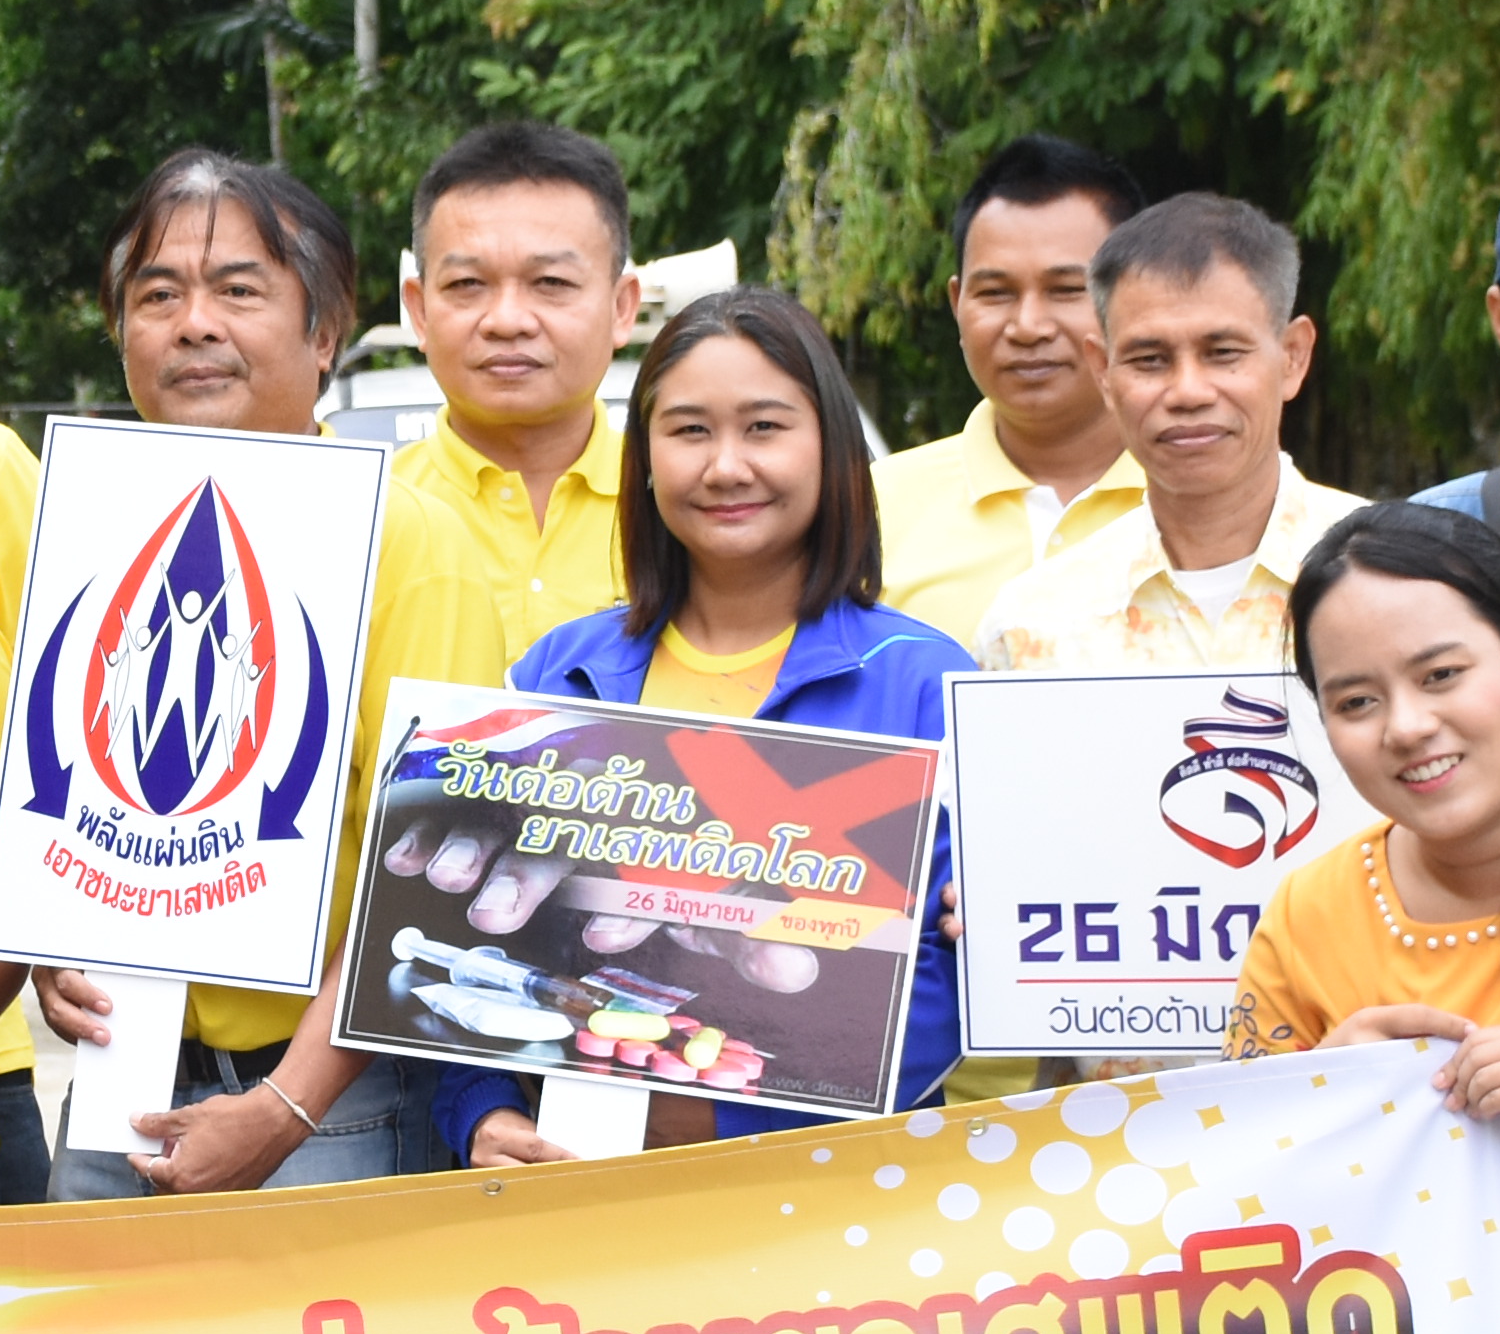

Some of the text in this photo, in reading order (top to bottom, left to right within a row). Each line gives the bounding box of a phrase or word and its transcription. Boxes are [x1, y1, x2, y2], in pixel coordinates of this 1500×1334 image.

[437, 738, 696, 824] วันต่อต้าน
[76, 805, 244, 867] พลังแผ่นดิน
[517, 814, 867, 895] ยาเสพติดโลก
[43, 839, 267, 917] เอาชนะยาเสพติด
[625, 891, 860, 941] 26 มิถุนายน ของทุกปี
[1017, 902, 1121, 962] 26
